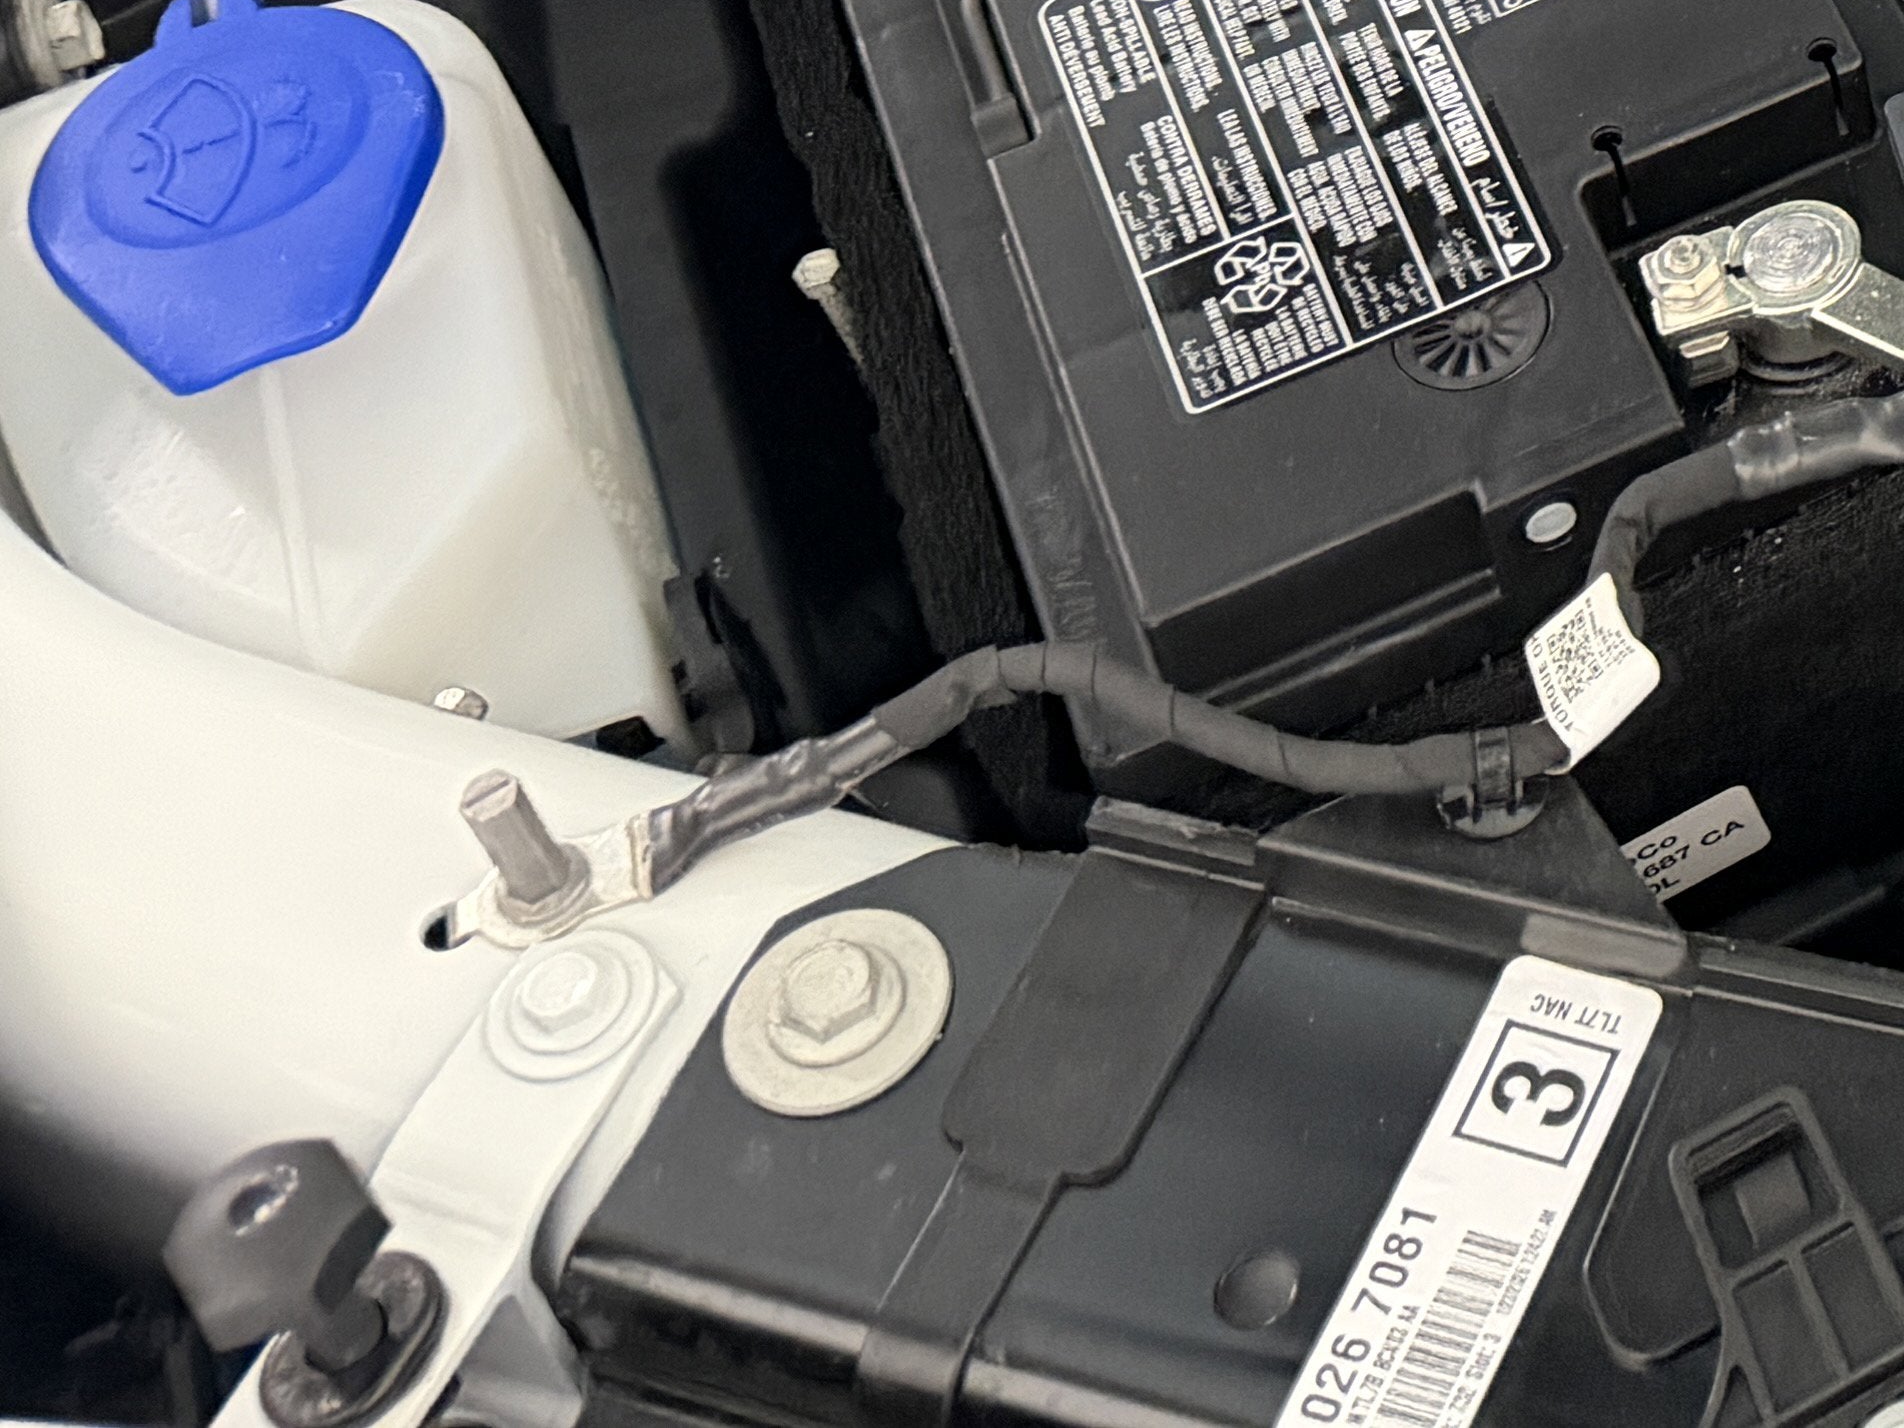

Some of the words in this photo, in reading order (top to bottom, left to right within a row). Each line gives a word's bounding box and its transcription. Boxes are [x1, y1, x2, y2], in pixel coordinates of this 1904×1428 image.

[1048, 12, 1071, 42] ANTI
[1098, 25, 1121, 53] Acid
[1059, 40, 1106, 129] DÉVERSEMENT
[1108, 51, 1137, 95] Battery
[1413, 43, 1490, 168] PELIGRO/VENENO
[1156, 114, 1188, 167] CONTRA
[1176, 165, 1216, 236] DERRAMES
[1701, 820, 1745, 846] CA
[1531, 991, 1570, 1023] NAC
[1574, 1005, 1621, 1036] TL7T
[1490, 1060, 1585, 1129] 3
[1301, 1333, 1372, 1423] 026
[1351, 1207, 1437, 1316] 7081
